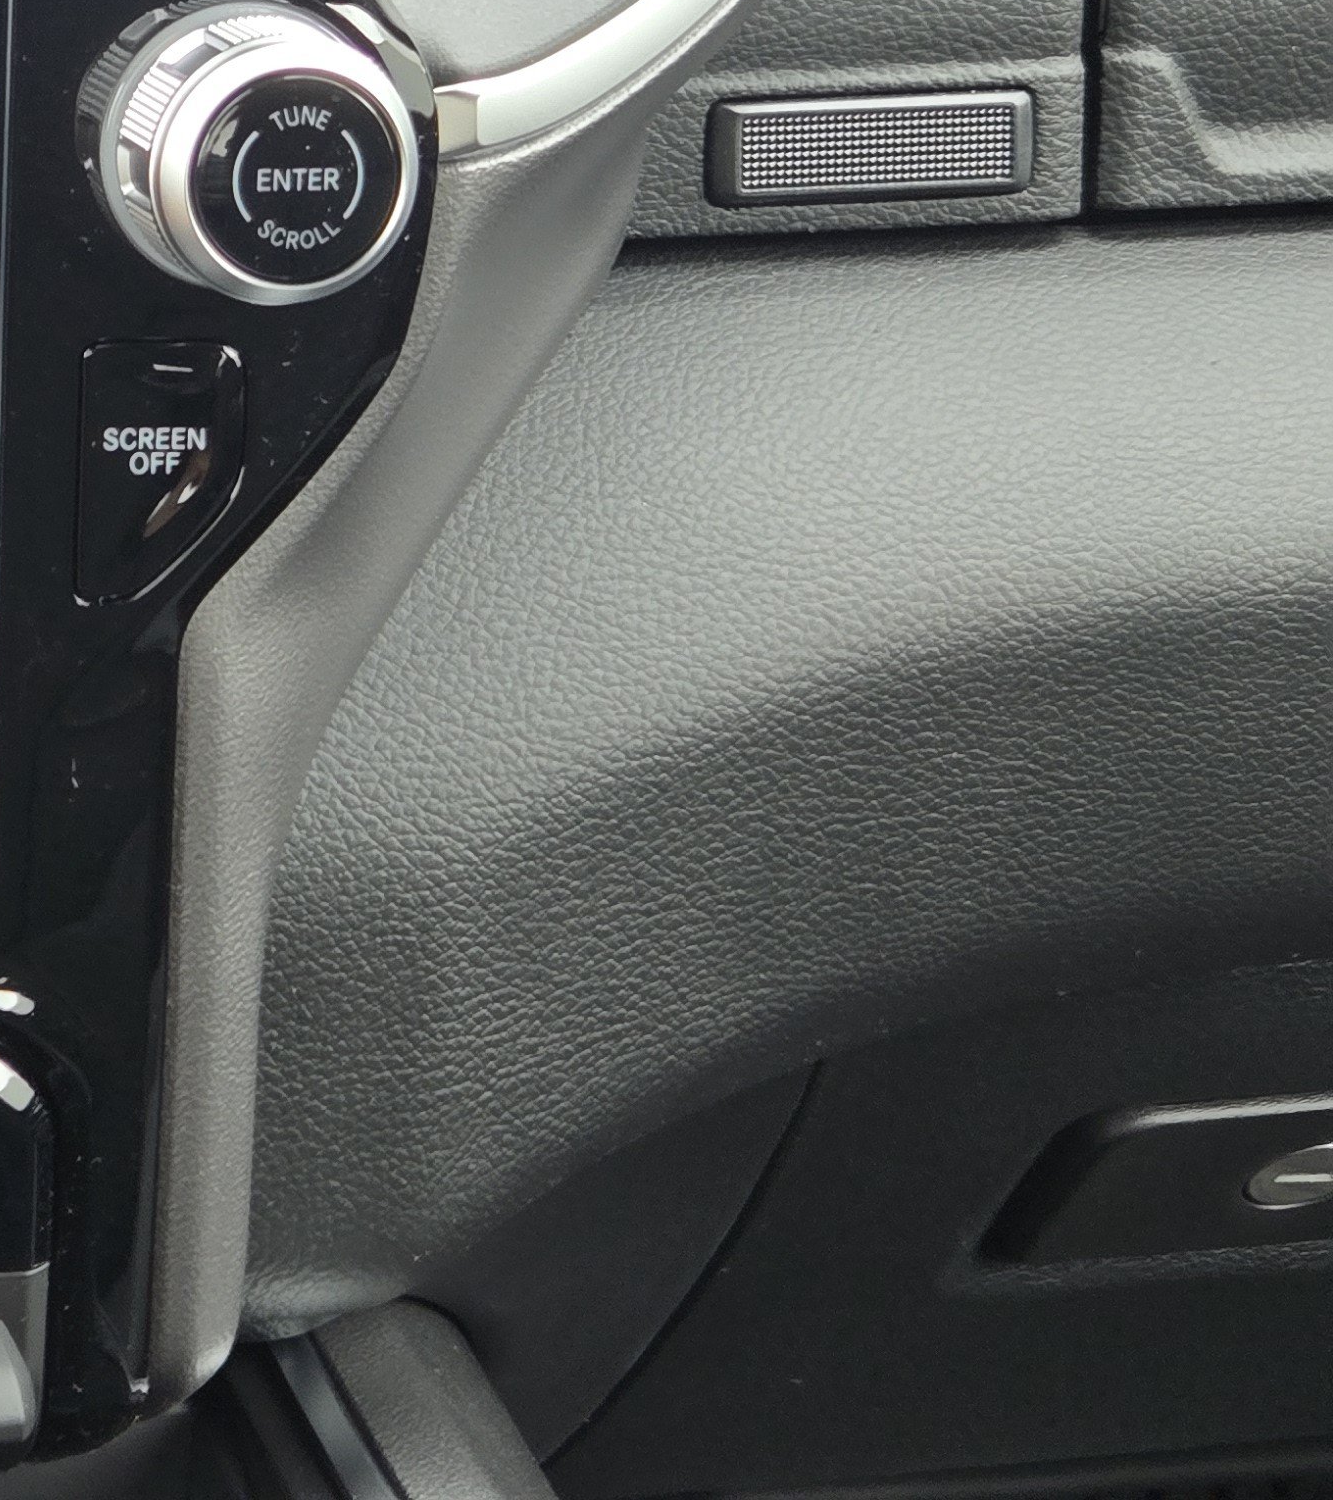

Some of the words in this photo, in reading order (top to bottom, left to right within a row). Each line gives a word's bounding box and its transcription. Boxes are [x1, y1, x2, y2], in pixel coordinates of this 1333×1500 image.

[268, 105, 333, 133] TUNE
[256, 167, 341, 193] ENTER
[258, 218, 342, 250] SCROLL
[102, 426, 207, 451] SCREEN
[129, 451, 181, 476] OFF
